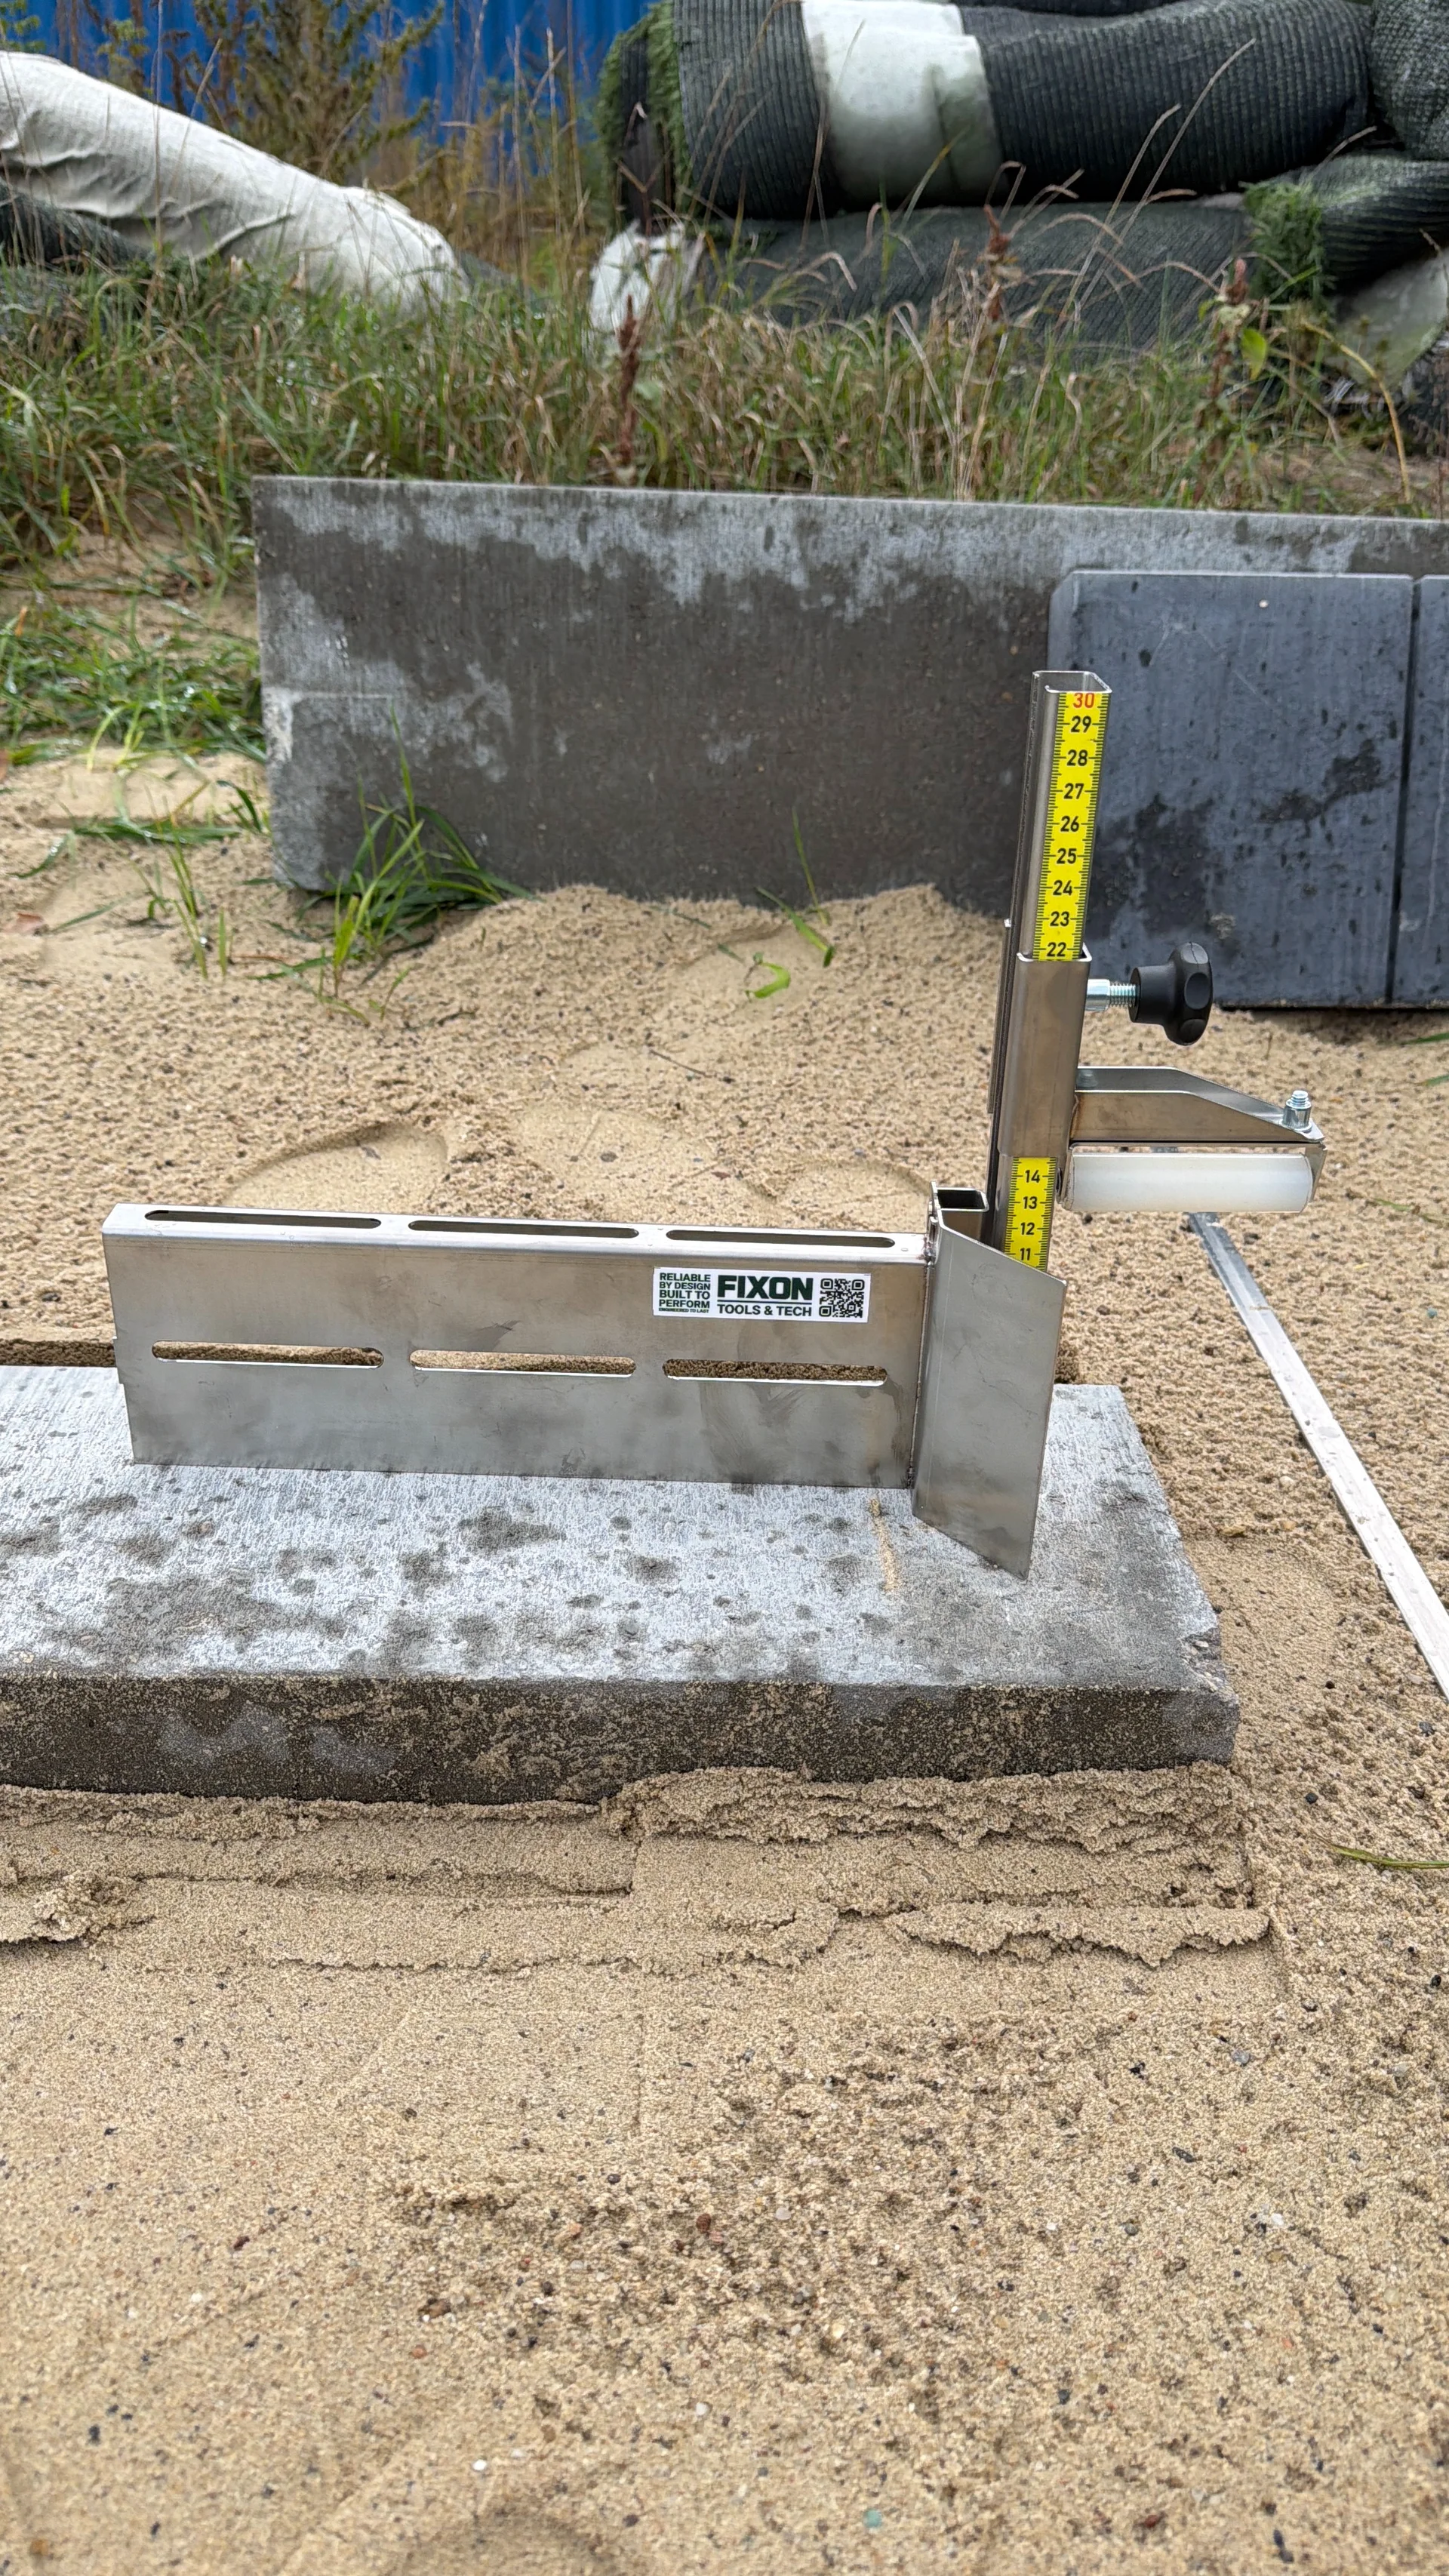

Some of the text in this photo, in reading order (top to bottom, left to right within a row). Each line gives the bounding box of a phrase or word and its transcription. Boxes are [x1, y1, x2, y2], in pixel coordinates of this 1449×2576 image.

[1072, 693, 1094, 708] 30
[1070, 716, 1092, 733] 29
[1066, 749, 1088, 766] 28
[1063, 783, 1084, 799] 27
[1060, 816, 1079, 833] 26
[1056, 848, 1077, 864] 25
[1053, 880, 1072, 896] 24
[1050, 911, 1069, 927] 23
[1047, 942, 1066, 957] 22
[1025, 1170, 1041, 1183] 14
[1023, 1196, 1038, 1209] 13
[1020, 1222, 1035, 1236] 12
[1020, 1248, 1031, 1261] 11
[660, 1273, 711, 1282] RELIABLE
[674, 1282, 711, 1291] DESIGN
[717, 1275, 814, 1300] FIXON
[659, 1289, 710, 1300] BUILT TO
[659, 1299, 710, 1309] PERFORM
[717, 1303, 812, 1316] TOOLS & TECH
